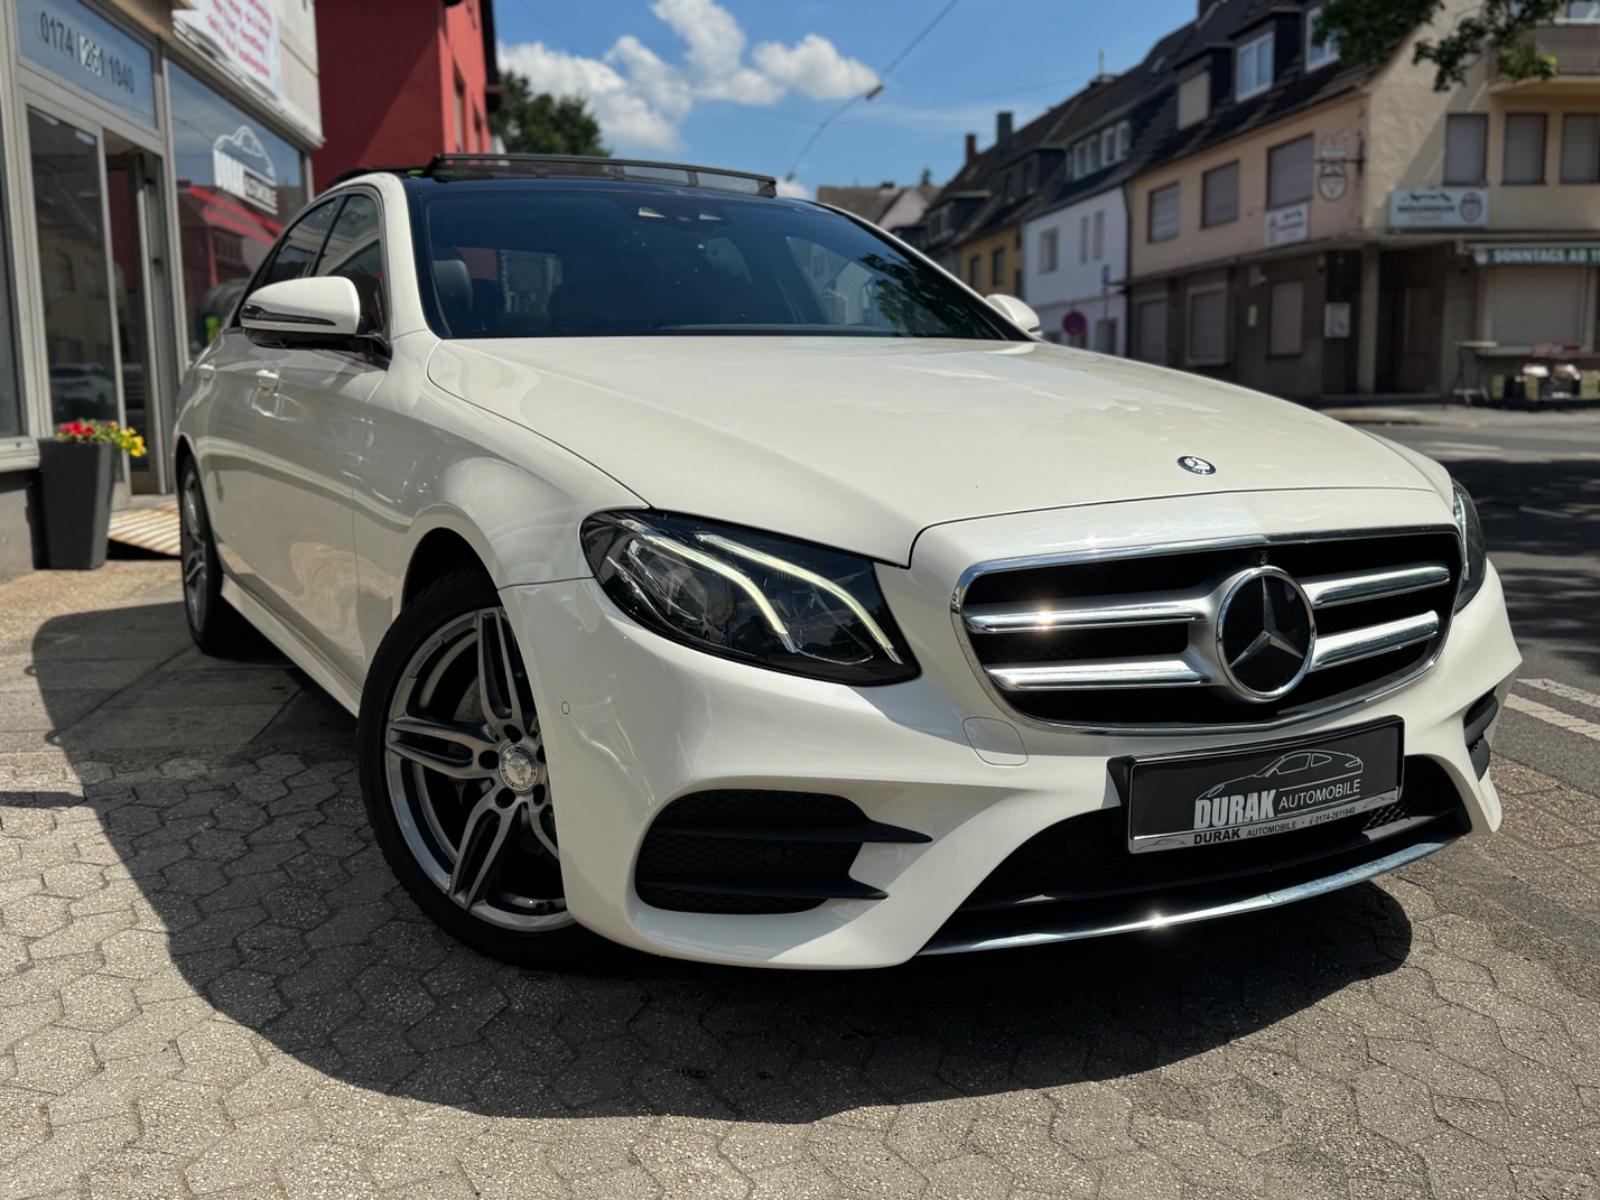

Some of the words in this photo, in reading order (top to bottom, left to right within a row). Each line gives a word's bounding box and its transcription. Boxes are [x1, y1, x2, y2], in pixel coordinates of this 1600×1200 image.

[40, 11, 74, 59] 0174
[108, 55, 135, 94] 1940
[1494, 249, 1564, 263] SONNTAGS
[1193, 789, 1277, 830] DURAK
[1278, 779, 1361, 810] AUTOMOBILE
[1193, 828, 1241, 845] DURAK
[1246, 821, 1296, 838] AUTOMOBILE
